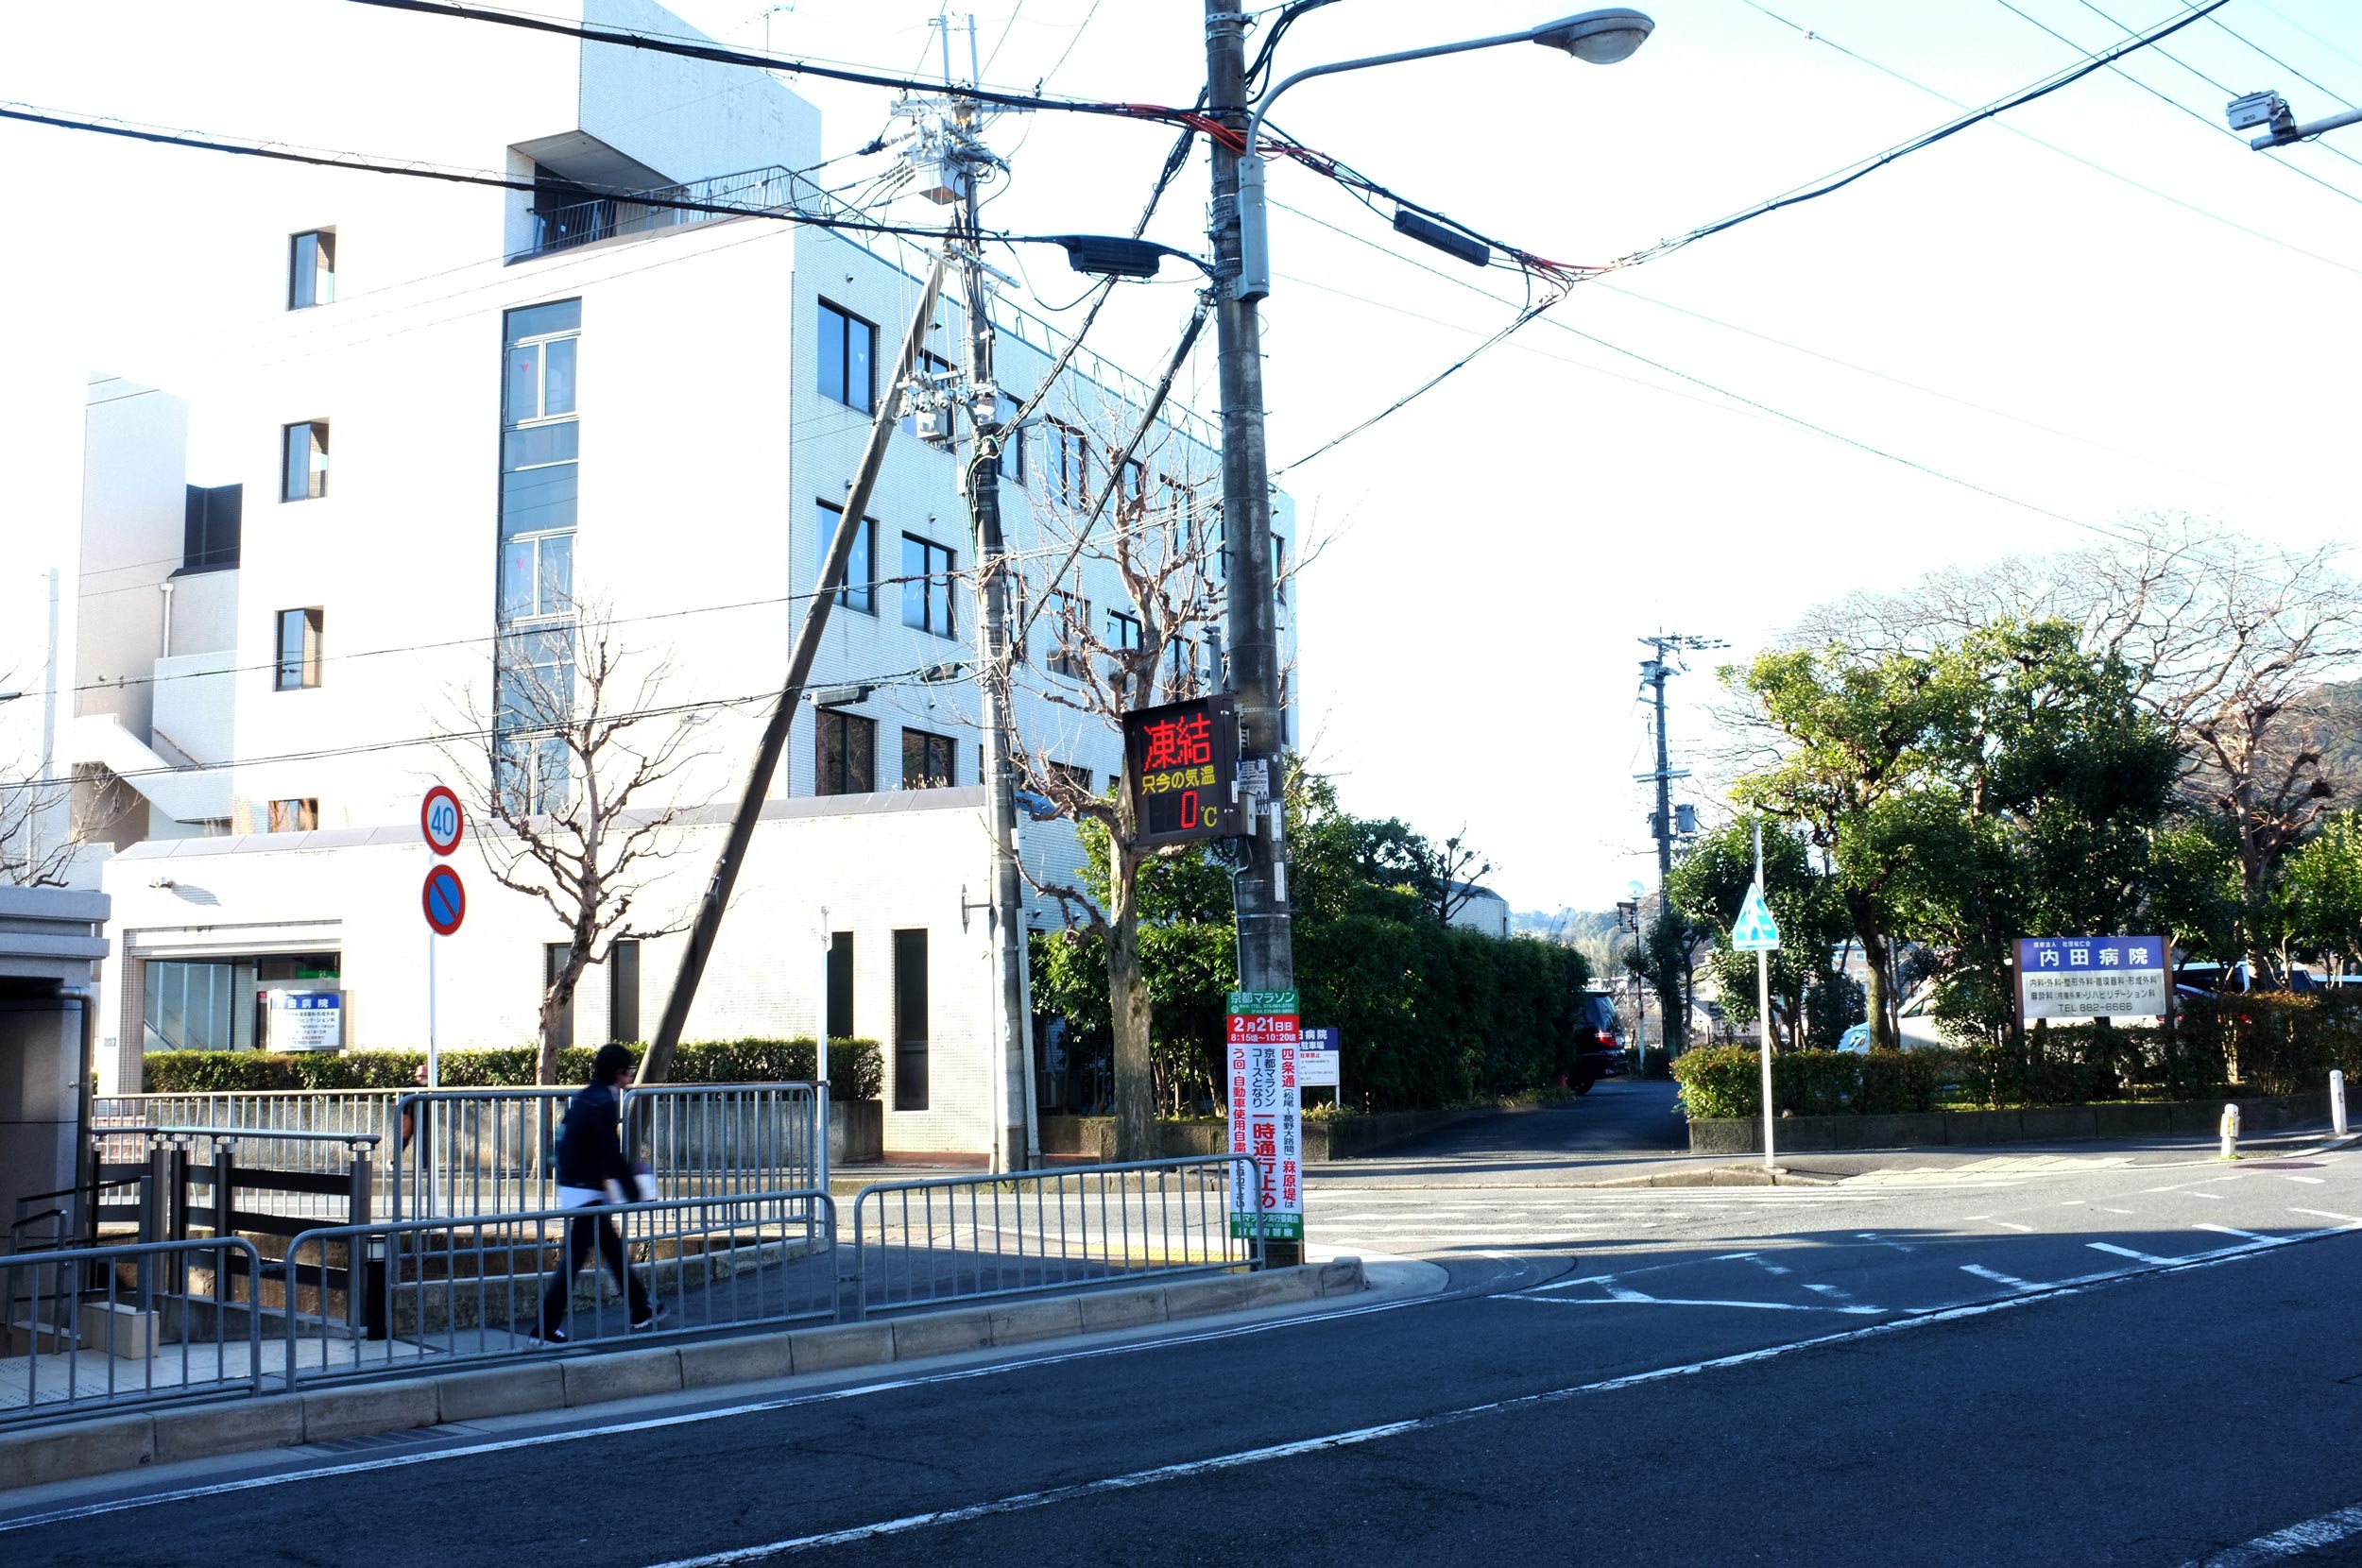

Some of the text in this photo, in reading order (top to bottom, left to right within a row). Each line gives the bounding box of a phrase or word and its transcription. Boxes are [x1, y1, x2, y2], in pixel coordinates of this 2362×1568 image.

[1143, 712, 1212, 772] 凍結
[1141, 765, 1216, 795] 只今の気温
[431, 805, 454, 837] 40
[2040, 946, 2148, 967] 内田病院
[1230, 992, 1295, 1004] 京都マラソン
[2058, 1002, 2133, 1013] TEL 882-6666
[1252, 1048, 1263, 1108] コースとなり
[1264, 1048, 1275, 1107] 京都マラソン
